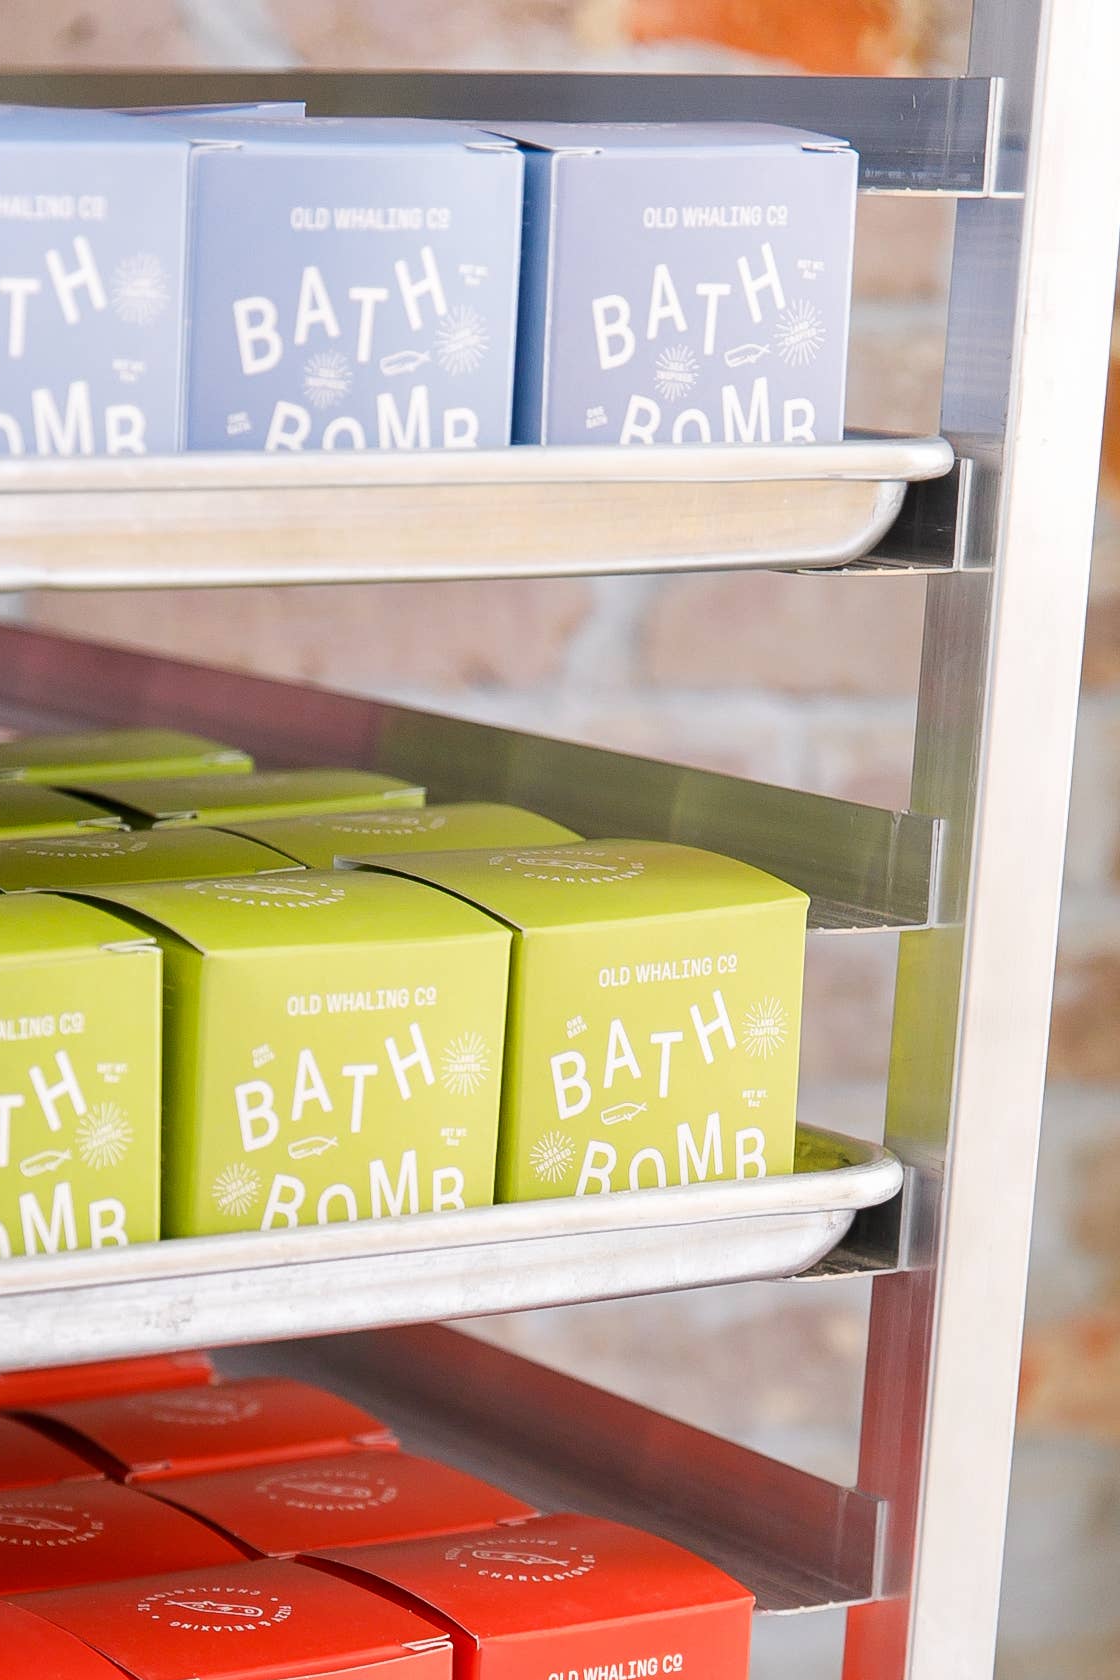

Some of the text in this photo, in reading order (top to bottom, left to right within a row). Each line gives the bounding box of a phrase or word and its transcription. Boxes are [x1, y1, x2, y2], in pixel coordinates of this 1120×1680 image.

[290, 206, 331, 231] OLD
[333, 209, 422, 231] WHALING
[642, 206, 679, 229] OLD
[682, 205, 763, 228] WHALING
[233, 245, 448, 375] BATH
[592, 240, 787, 370] BATH
[286, 993, 323, 1017] OLD
[325, 987, 410, 1013] WHALING
[599, 968, 630, 987] OLD
[634, 956, 713, 983] WHALING
[234, 1022, 436, 1152] BATH
[550, 988, 737, 1120] BATH
